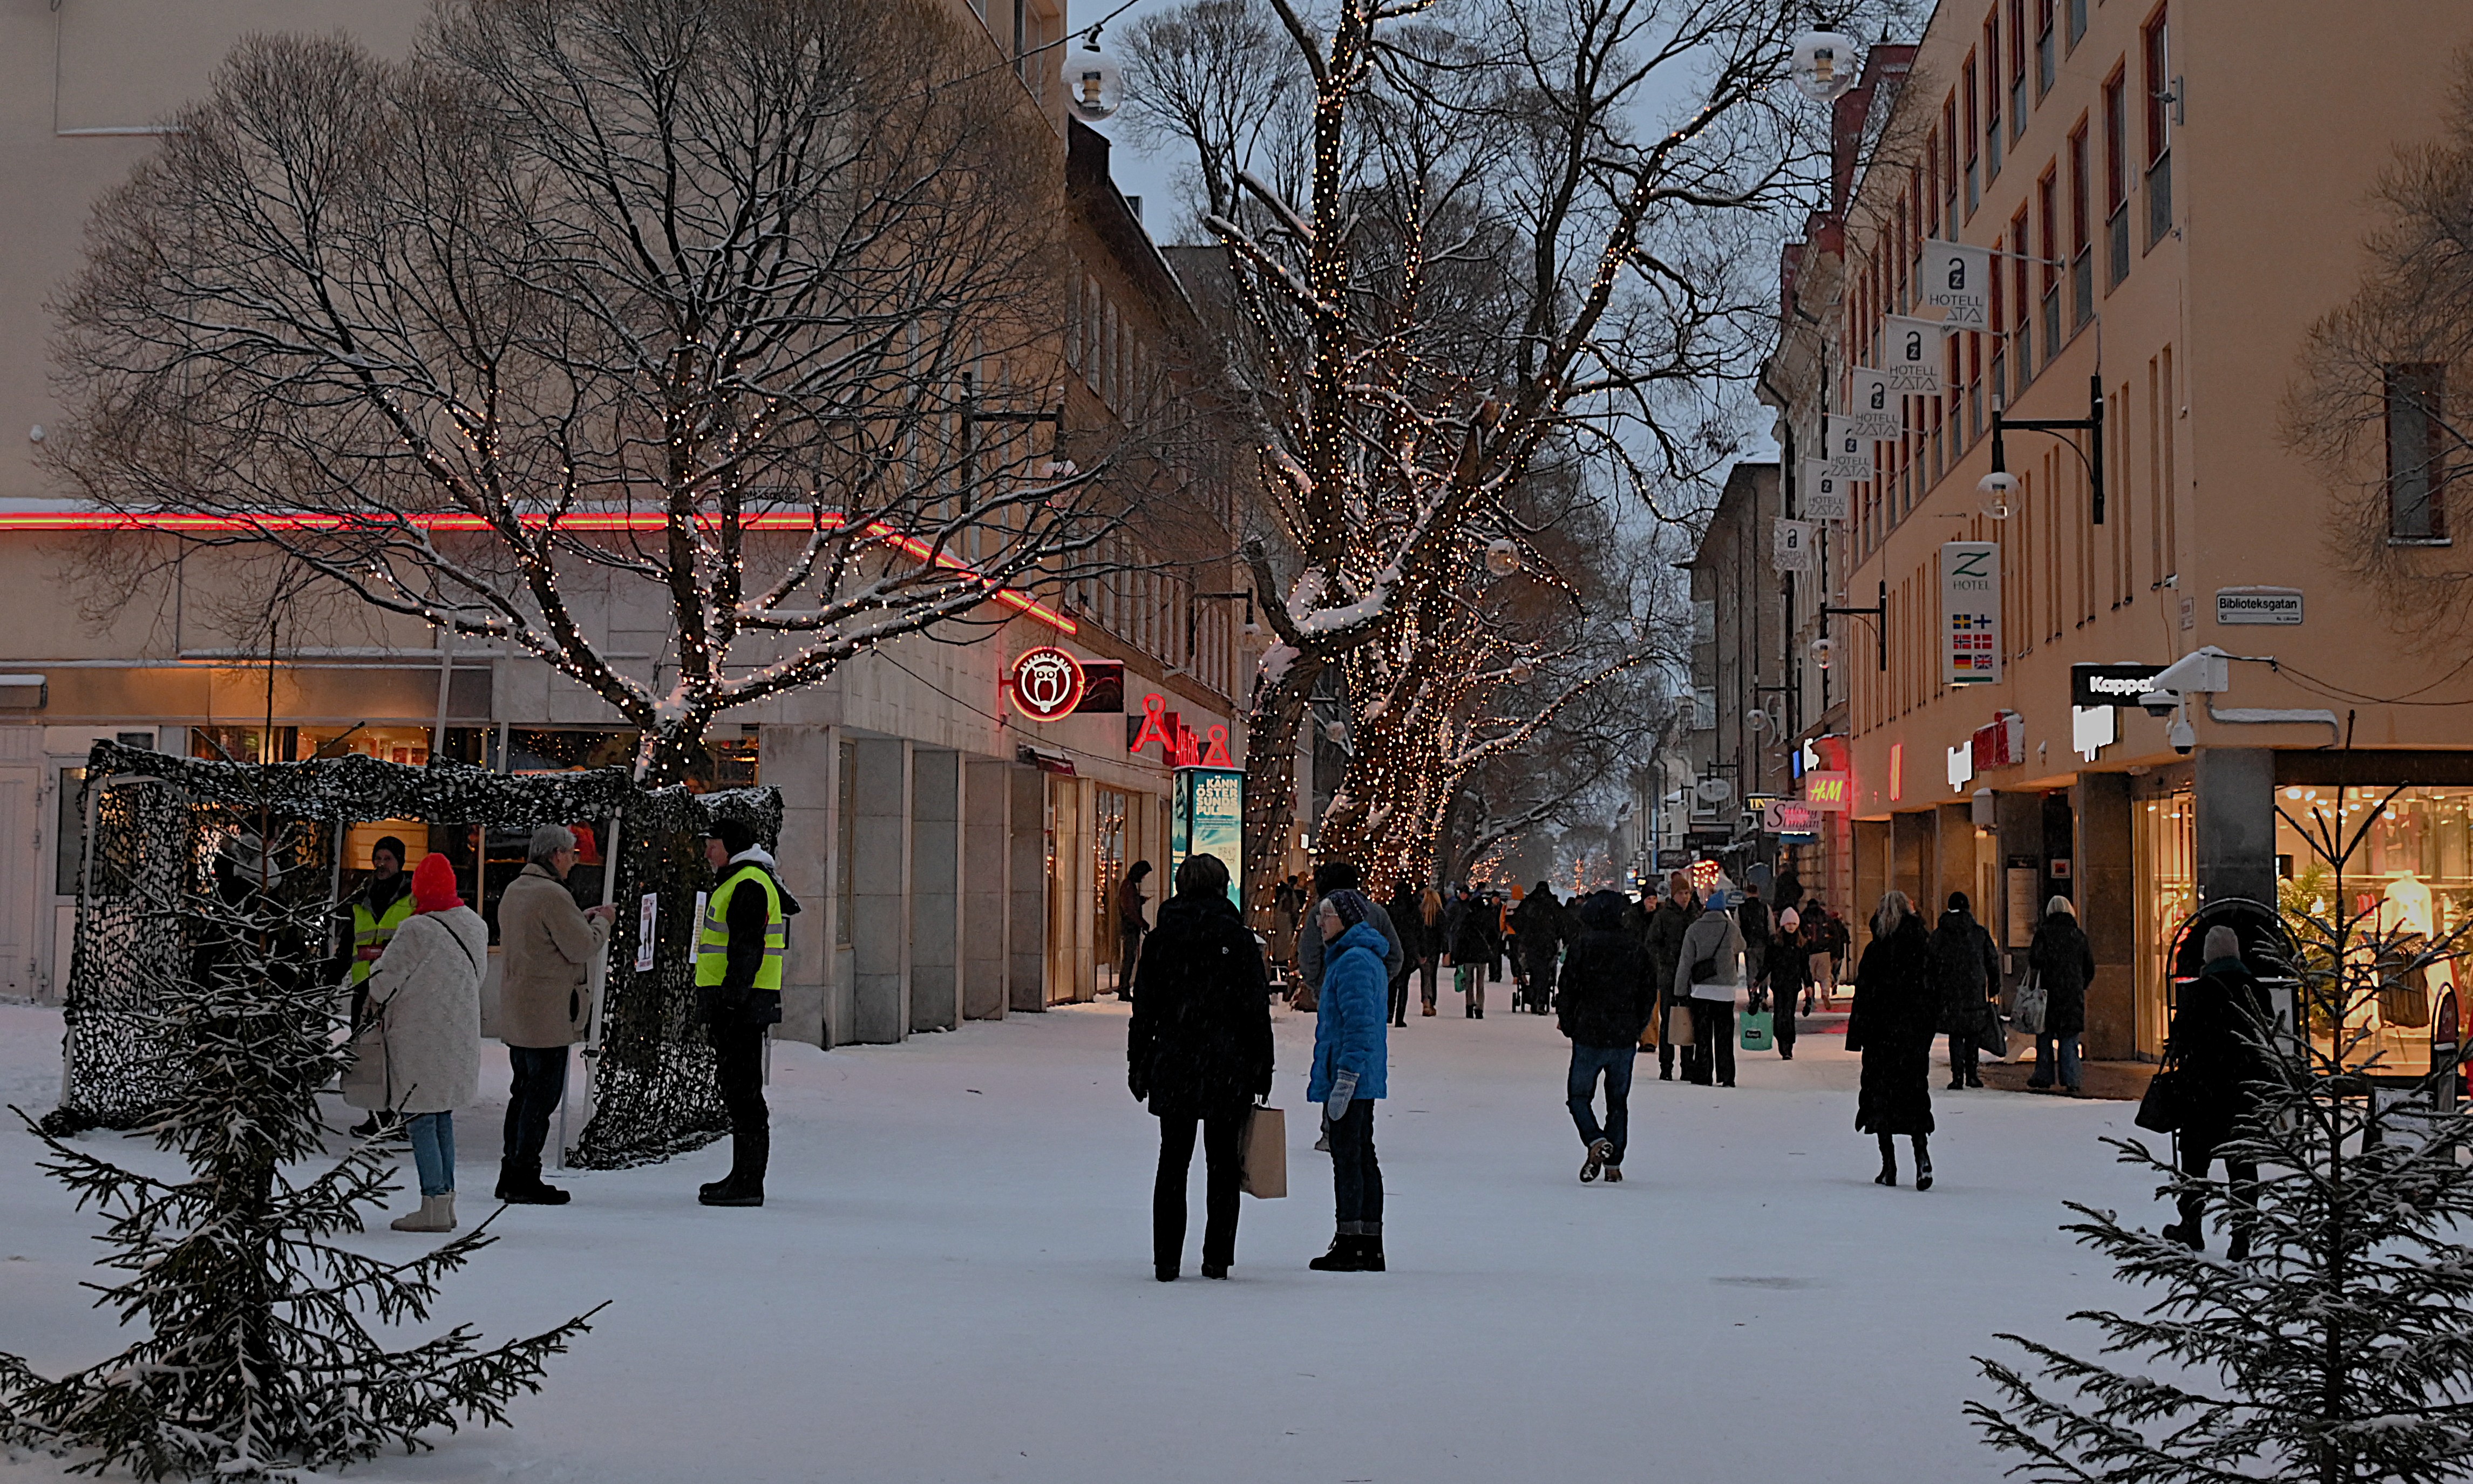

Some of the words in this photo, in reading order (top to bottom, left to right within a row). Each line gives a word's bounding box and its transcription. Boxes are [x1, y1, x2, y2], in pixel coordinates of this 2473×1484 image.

[1930, 295, 1982, 306] HOTELL
[1947, 307, 1982, 323] ATA
[1890, 365, 1937, 376] HOTELL
[1856, 413, 1899, 424] HOTELL
[1831, 456, 1871, 465] HOTELL
[1809, 496, 1844, 505] HOTELL
[1952, 552, 1990, 577] Z
[1953, 580, 1989, 590] HOTEL
[2219, 597, 2297, 611] Biblioteksgatan
[1130, 693, 1177, 752] Å
[1206, 775, 1238, 788] KÄNN
[1196, 784, 1238, 798] ÖSTER
[1810, 780, 1844, 802] H&M
[1196, 797, 1238, 806] SUNDS
